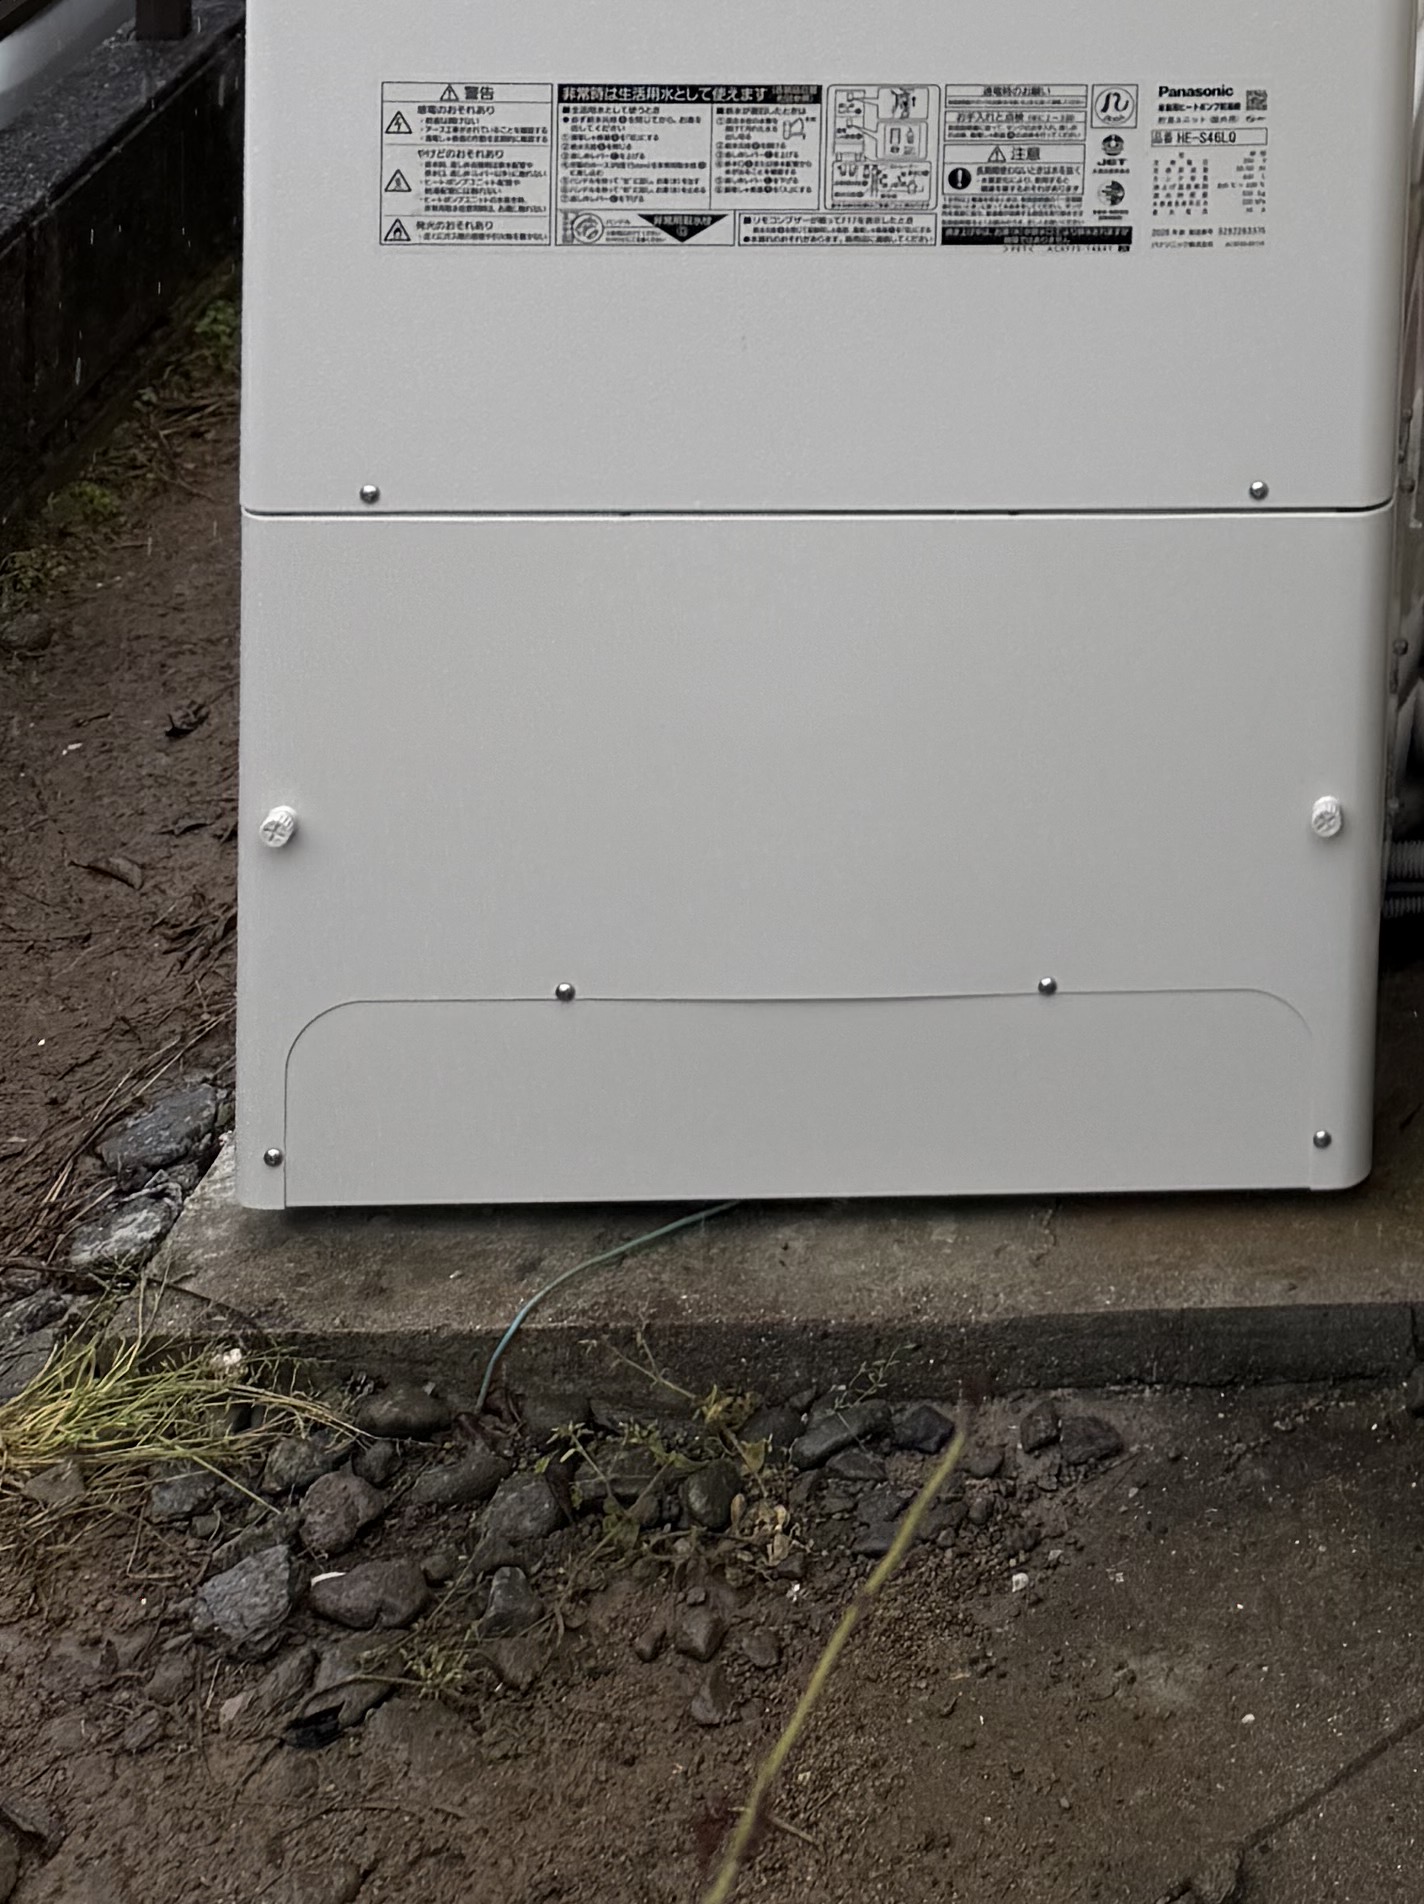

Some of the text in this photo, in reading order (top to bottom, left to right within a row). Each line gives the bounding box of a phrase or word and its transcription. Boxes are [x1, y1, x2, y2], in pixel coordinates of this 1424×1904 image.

[562, 87, 767, 102] 非常時は生活用水として使えます
[1158, 84, 1234, 97] Panasonic
[418, 149, 504, 159] やけどのおそれあり
